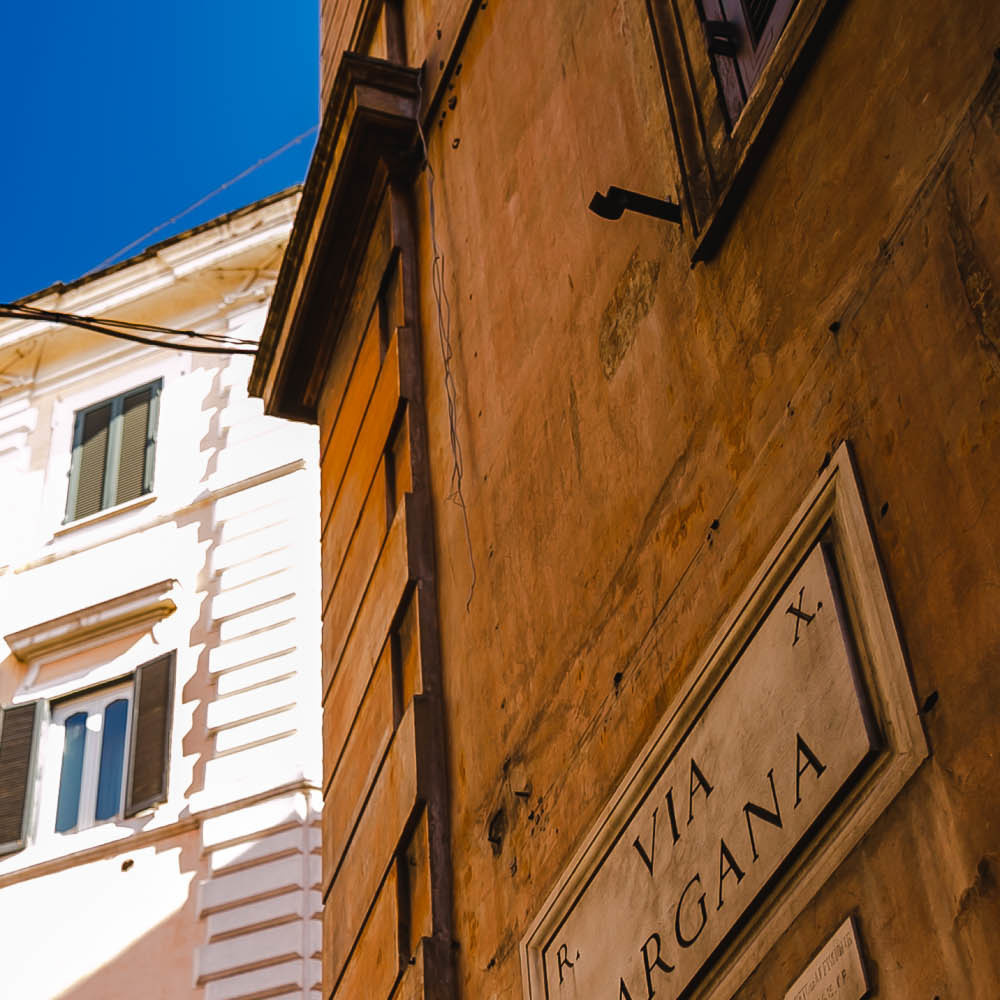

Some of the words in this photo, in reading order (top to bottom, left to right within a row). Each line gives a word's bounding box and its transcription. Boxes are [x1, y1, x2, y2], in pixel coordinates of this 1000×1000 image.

[786, 585, 824, 647] X.
[632, 757, 715, 877] VIA
[555, 943, 581, 985] R.
